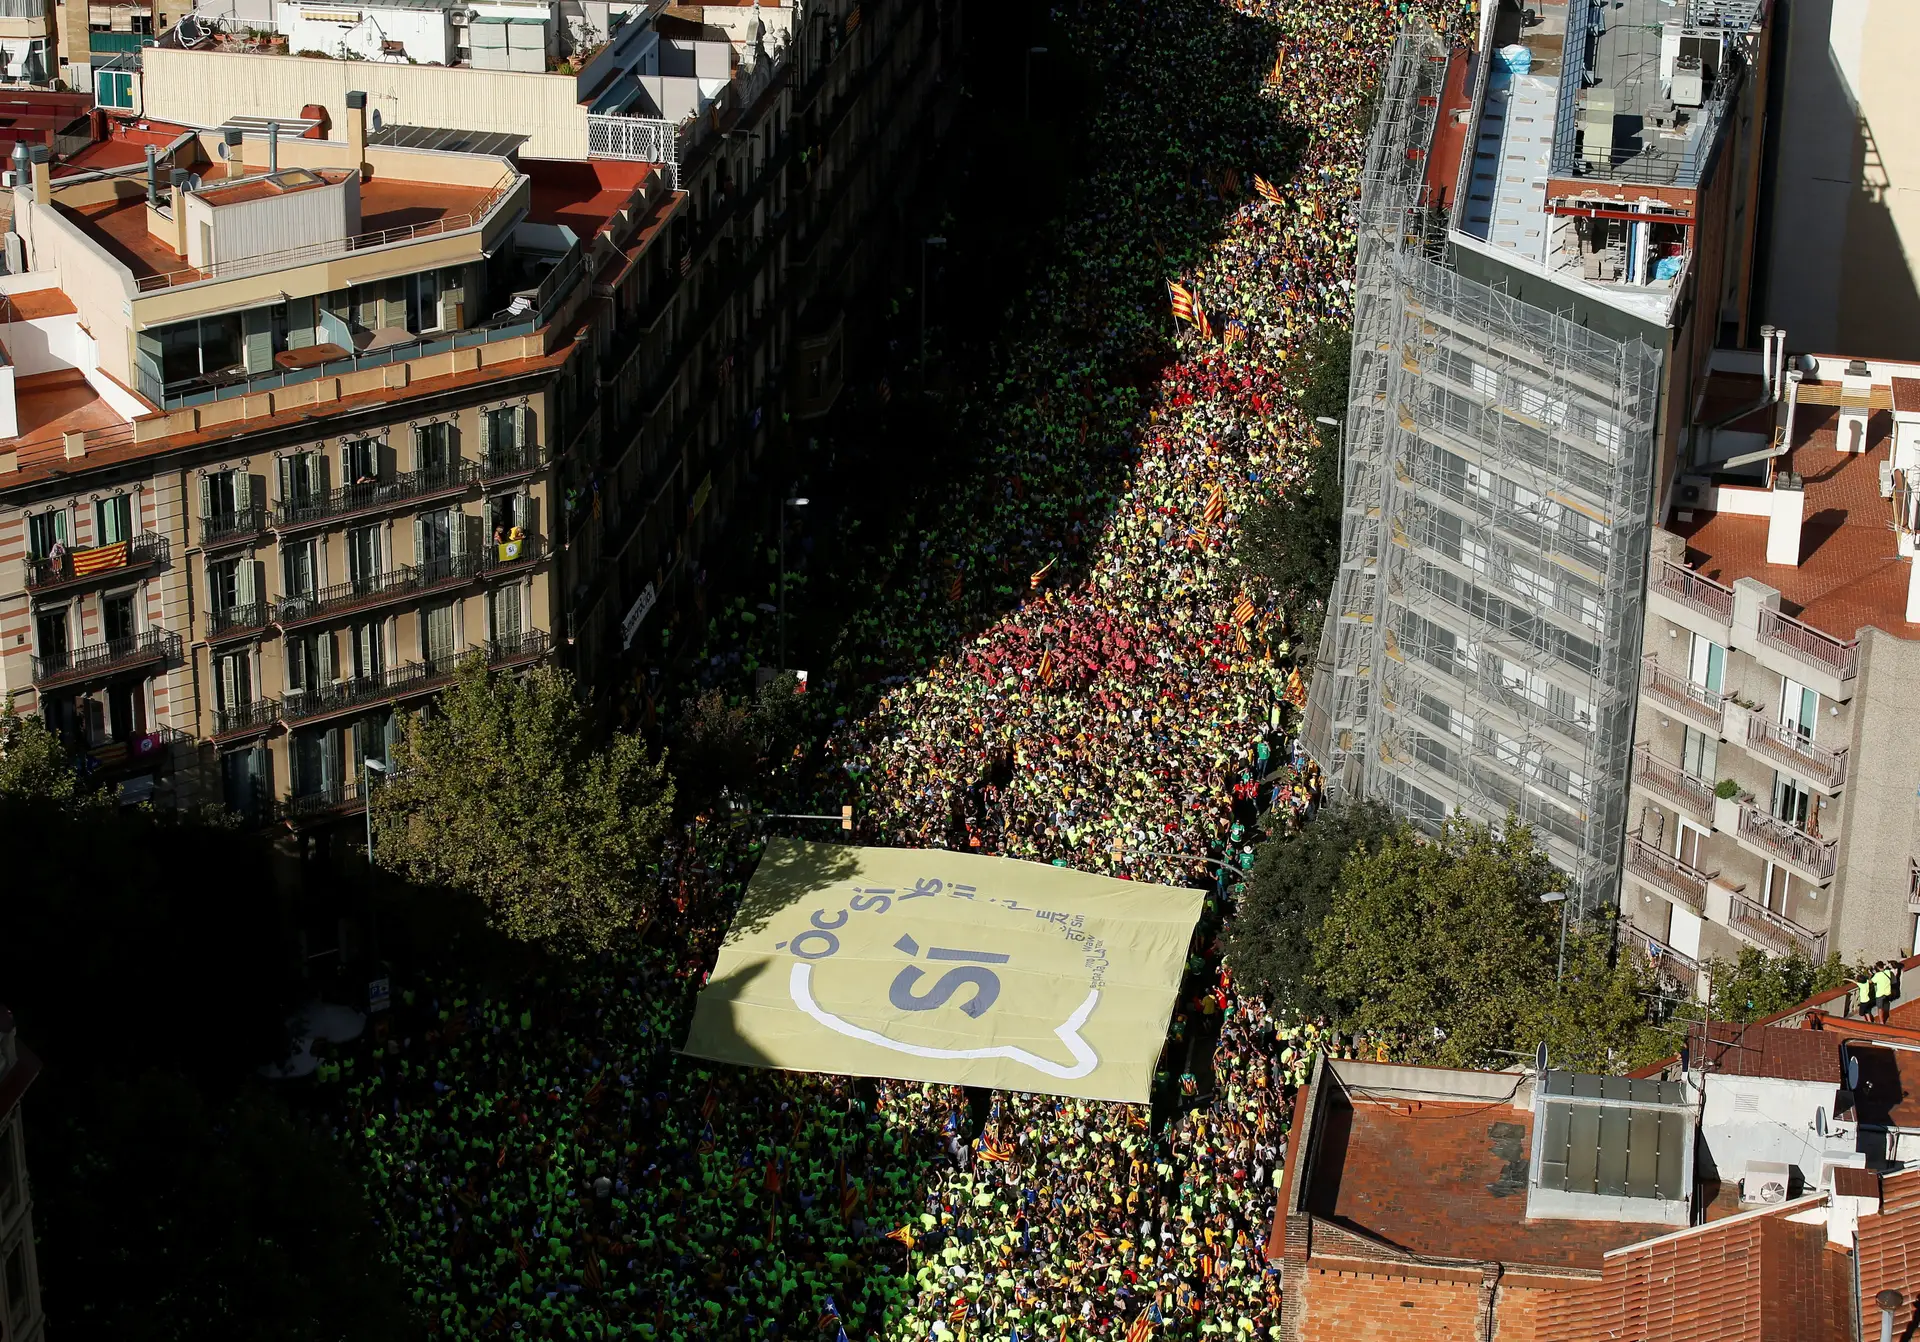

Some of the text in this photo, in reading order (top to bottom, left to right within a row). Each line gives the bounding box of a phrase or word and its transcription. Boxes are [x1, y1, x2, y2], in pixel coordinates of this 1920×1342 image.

[850, 887, 896, 914] Sí
[775, 908, 849, 959] Òc
[888, 932, 1011, 1020] Sí
